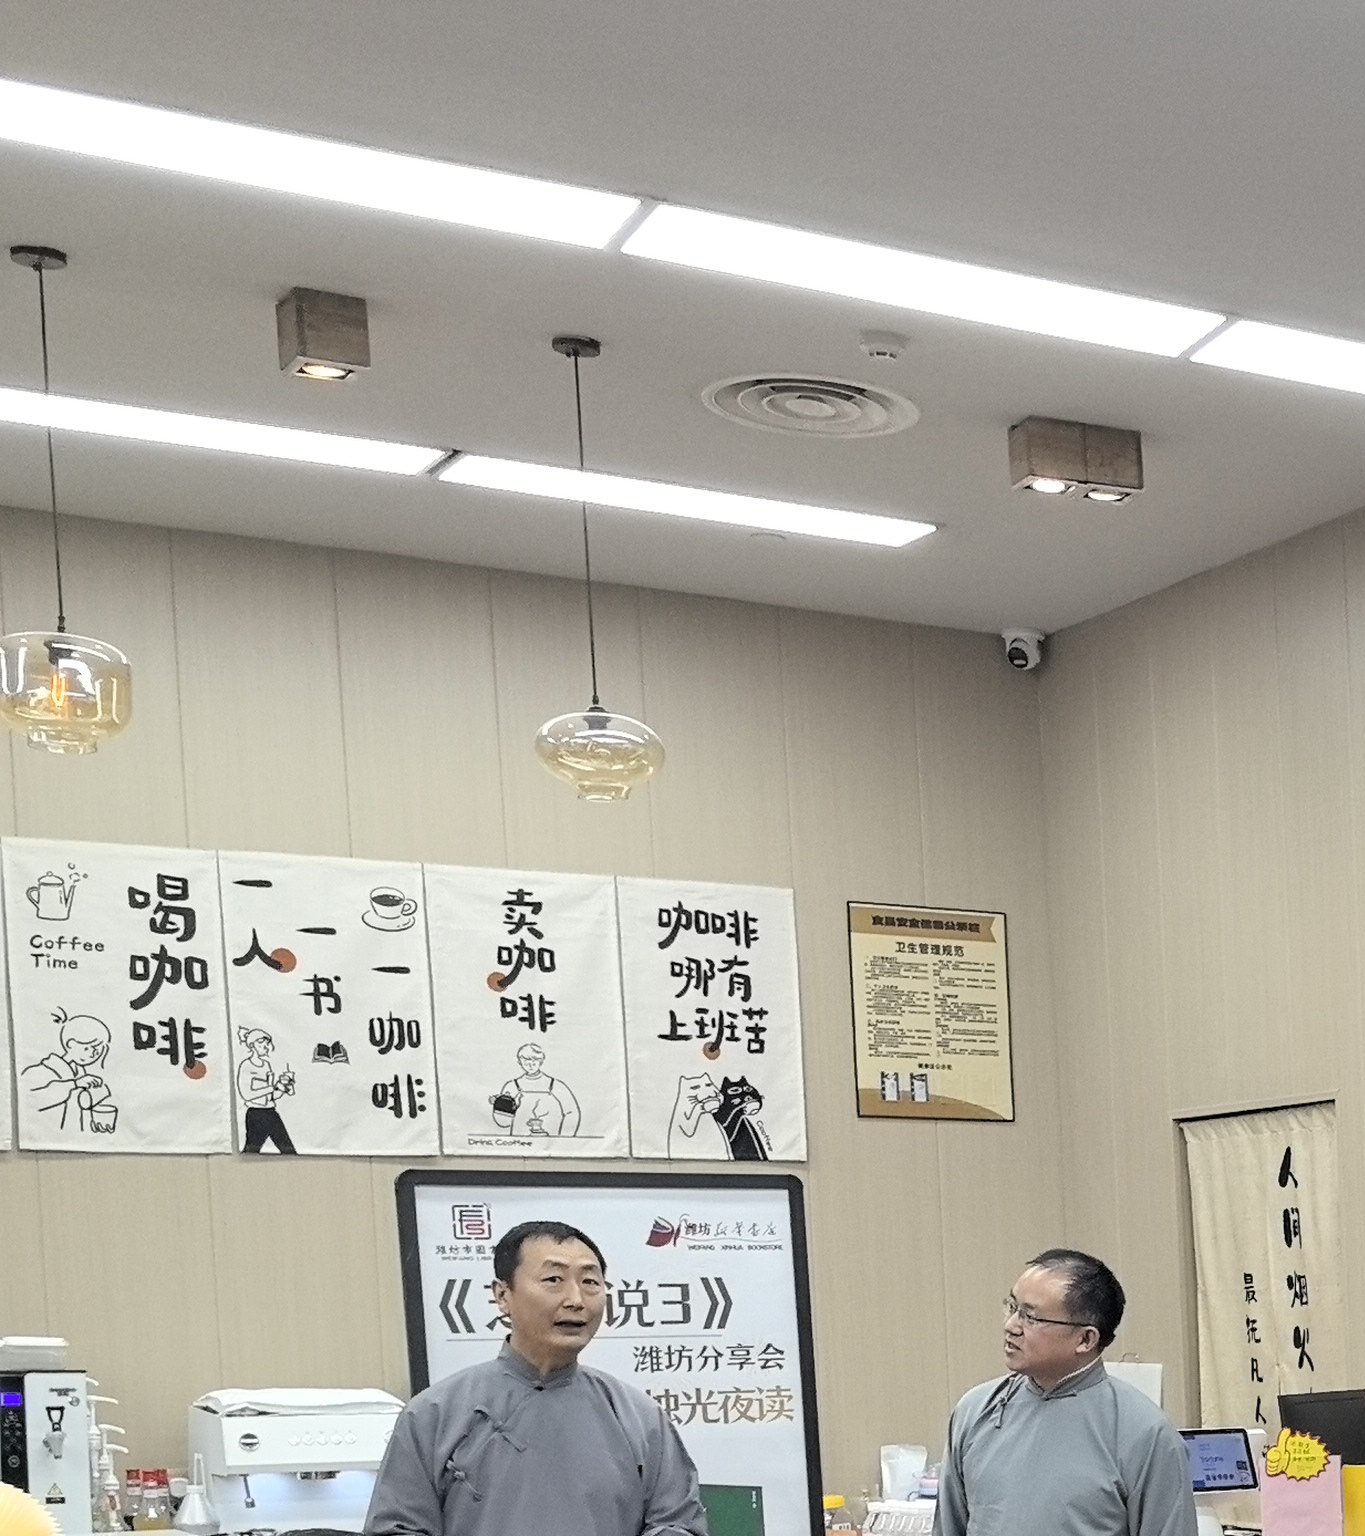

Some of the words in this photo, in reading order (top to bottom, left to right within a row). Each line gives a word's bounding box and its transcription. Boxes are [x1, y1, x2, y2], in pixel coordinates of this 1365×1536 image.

[29, 934, 105, 952] Coffee
[657, 901, 760, 949] 咖啡
[894, 941, 965, 957] 卫生管理规范
[30, 953, 78, 969] Time
[128, 873, 209, 1068] 喝咖啡
[496, 889, 556, 1033] 卖咖啡
[669, 957, 753, 1002] 哪有
[657, 1007, 768, 1055] 上班苦
[1278, 1146, 1314, 1371] 人间烟火
[439, 1277, 733, 1335] 《说3》
[633, 1343, 785, 1373] 潍坊分享会
